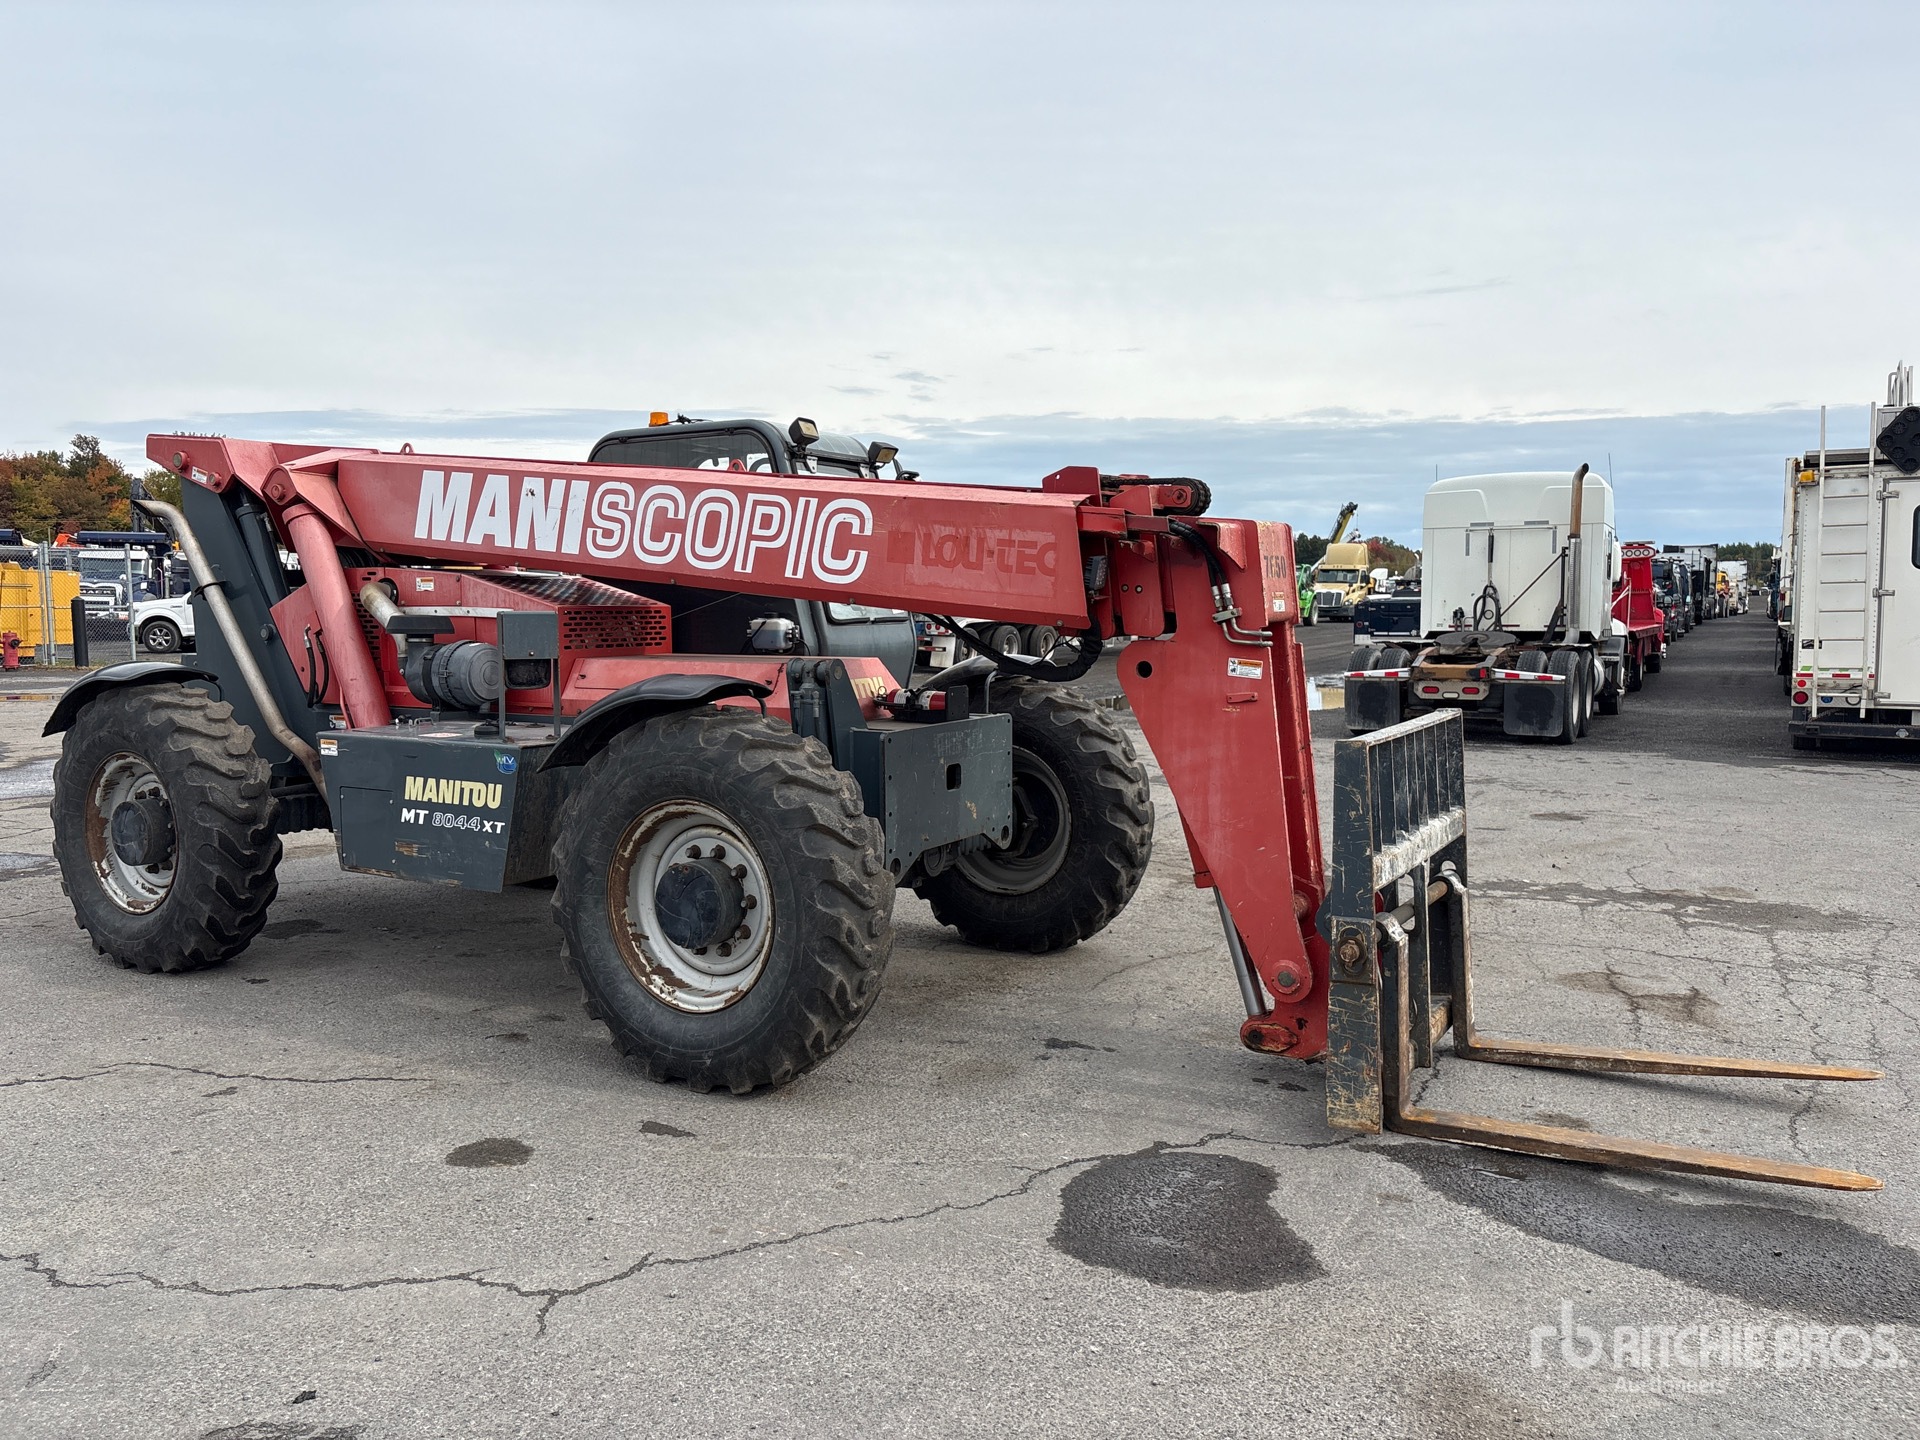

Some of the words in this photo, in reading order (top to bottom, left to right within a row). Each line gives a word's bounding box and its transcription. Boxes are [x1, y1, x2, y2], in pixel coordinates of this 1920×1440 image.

[414, 470, 873, 585] MANISCOPIC
[404, 775, 503, 809] MANITOU
[400, 807, 429, 825] MT
